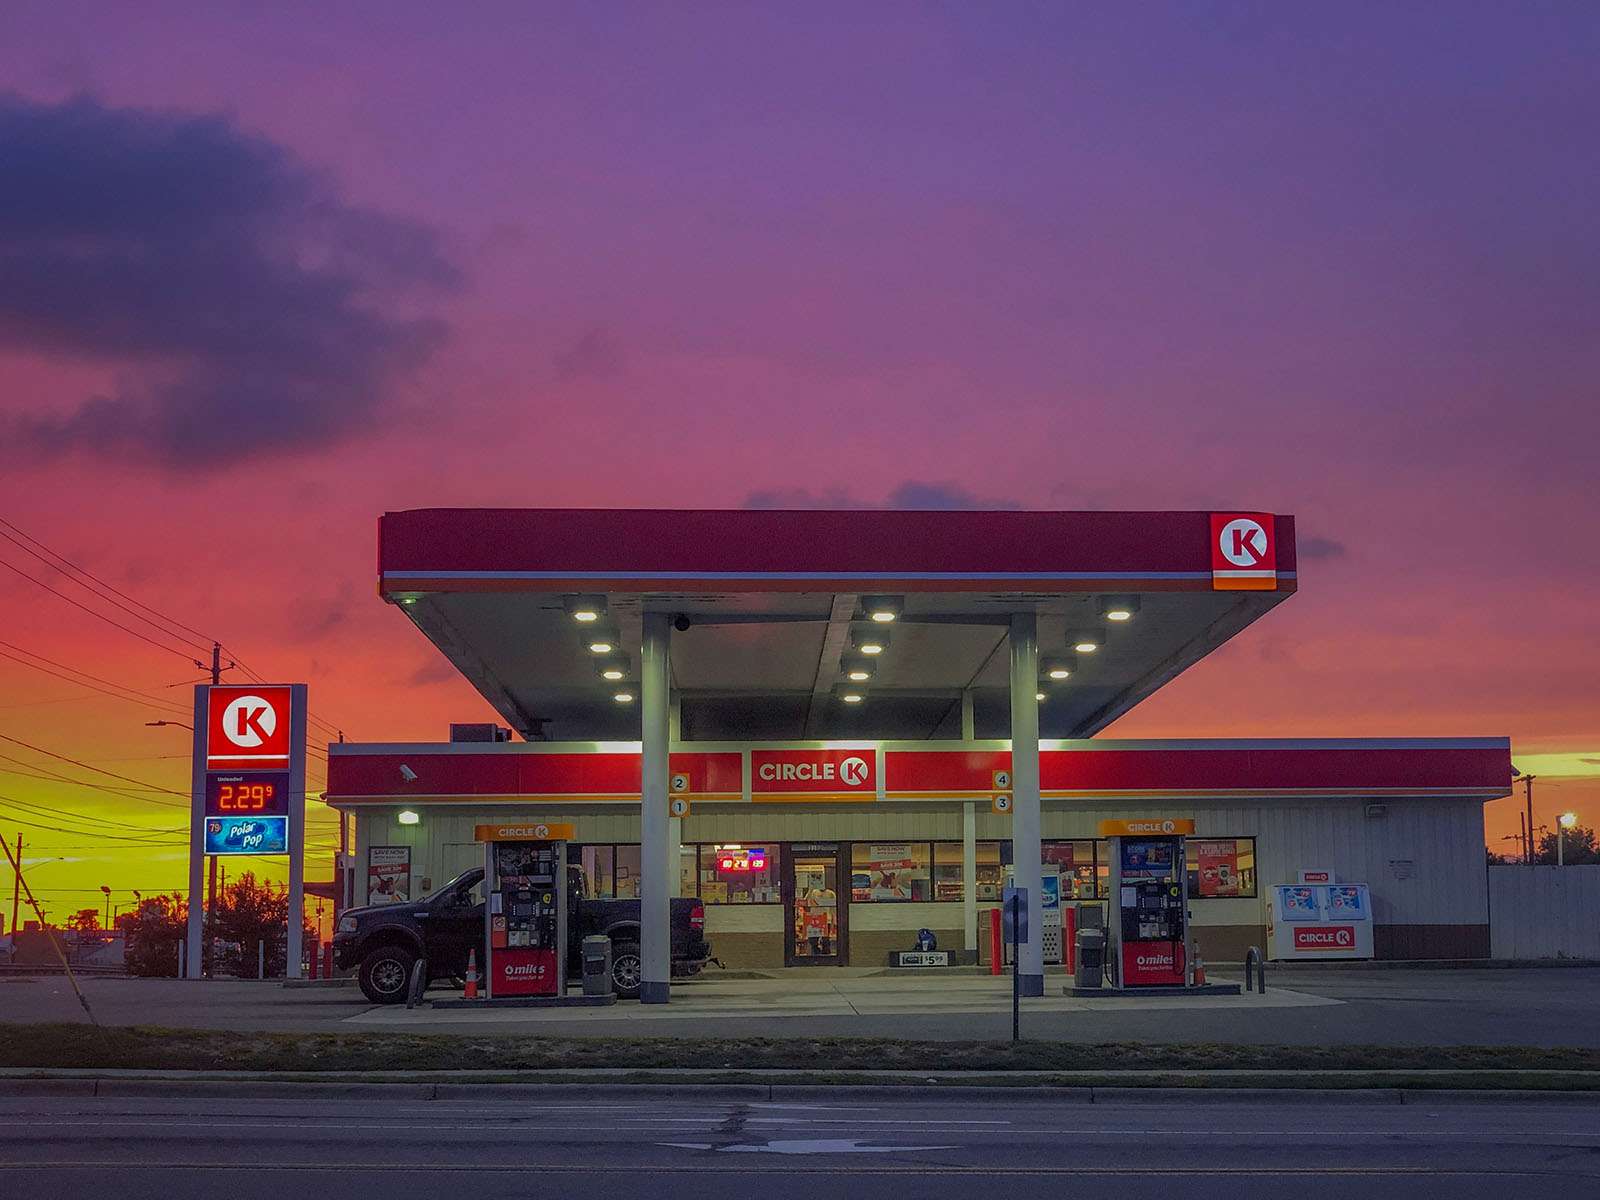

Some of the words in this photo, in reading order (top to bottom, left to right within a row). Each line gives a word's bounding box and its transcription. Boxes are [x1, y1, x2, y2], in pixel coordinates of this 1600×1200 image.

[1230, 527, 1264, 563] K
[235, 704, 273, 746] K
[759, 763, 835, 781] CIRCLE
[846, 762, 866, 784] K
[230, 822, 256, 838] Polar
[498, 828, 535, 837] CIRCLE
[1128, 823, 1161, 832] CIRCLE
[242, 834, 263, 848] Pop
[1299, 933, 1334, 943] CIRCLE
[1146, 955, 1173, 965] miles
